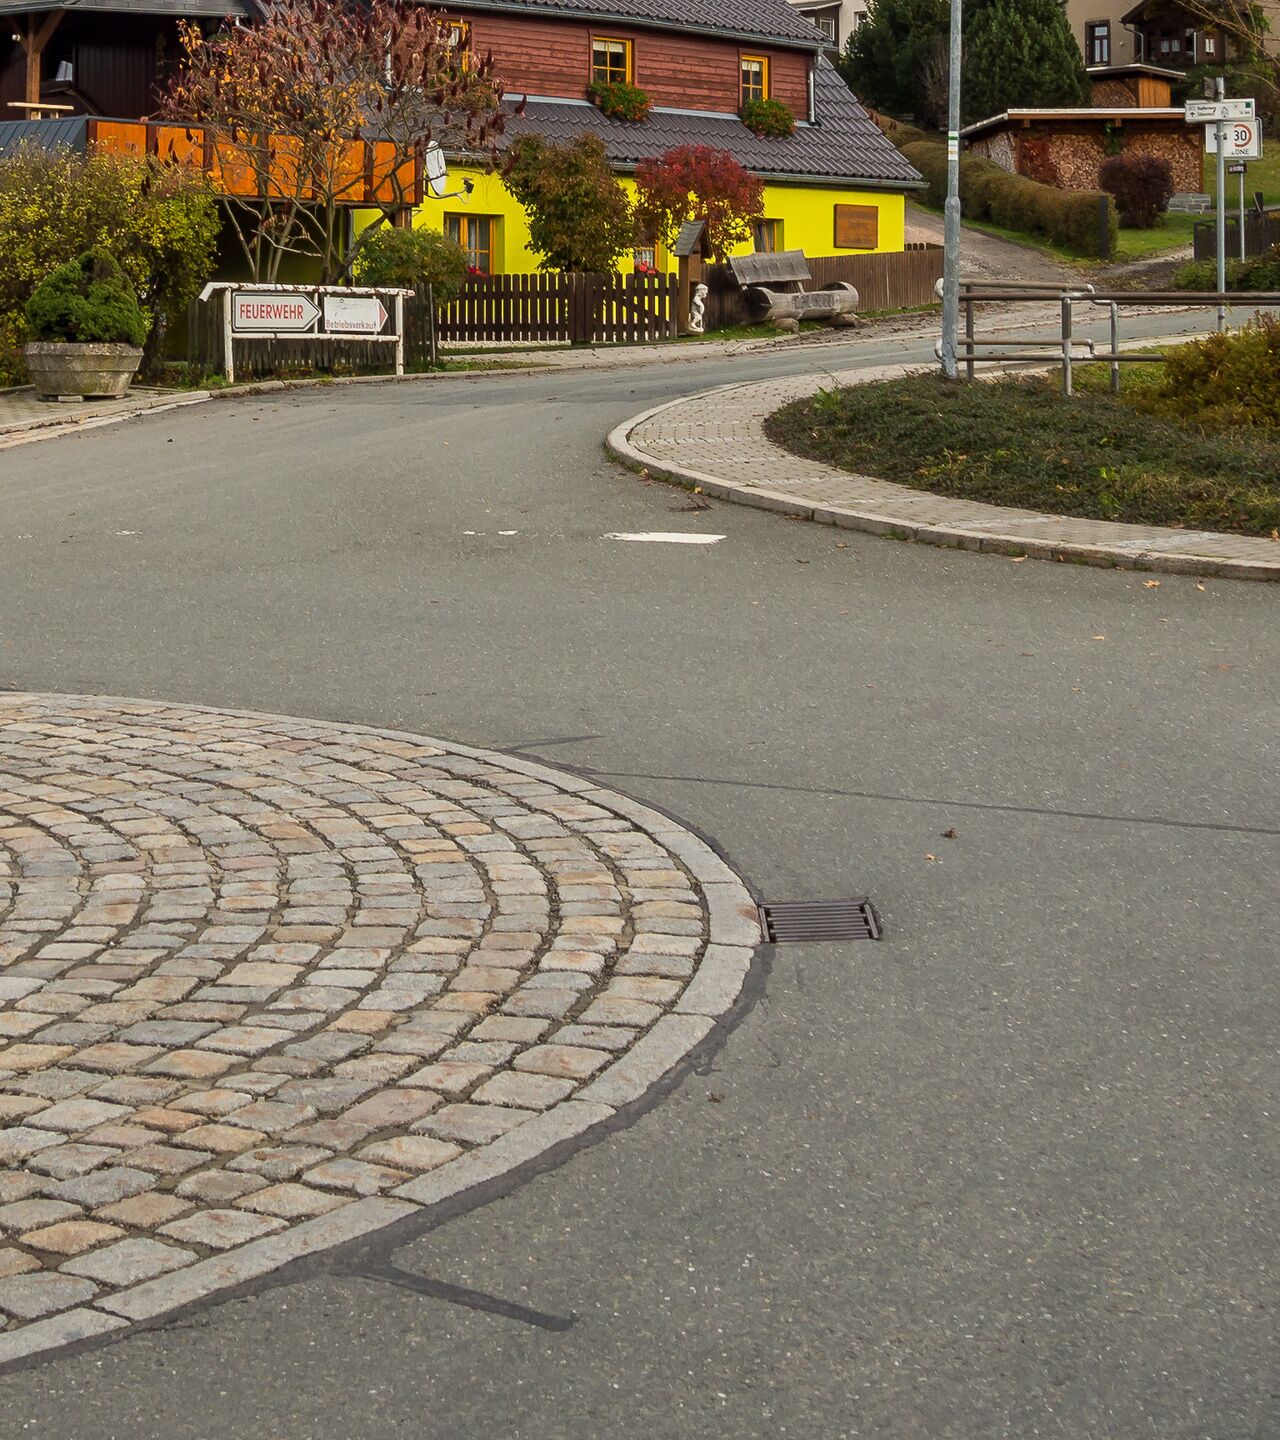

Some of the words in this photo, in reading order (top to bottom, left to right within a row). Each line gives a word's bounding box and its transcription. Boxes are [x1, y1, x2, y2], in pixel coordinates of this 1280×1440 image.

[1233, 130, 1247, 141] 30
[239, 303, 304, 320] FEUERWEHR
[326, 319, 377, 329] Betriebsverkauf
